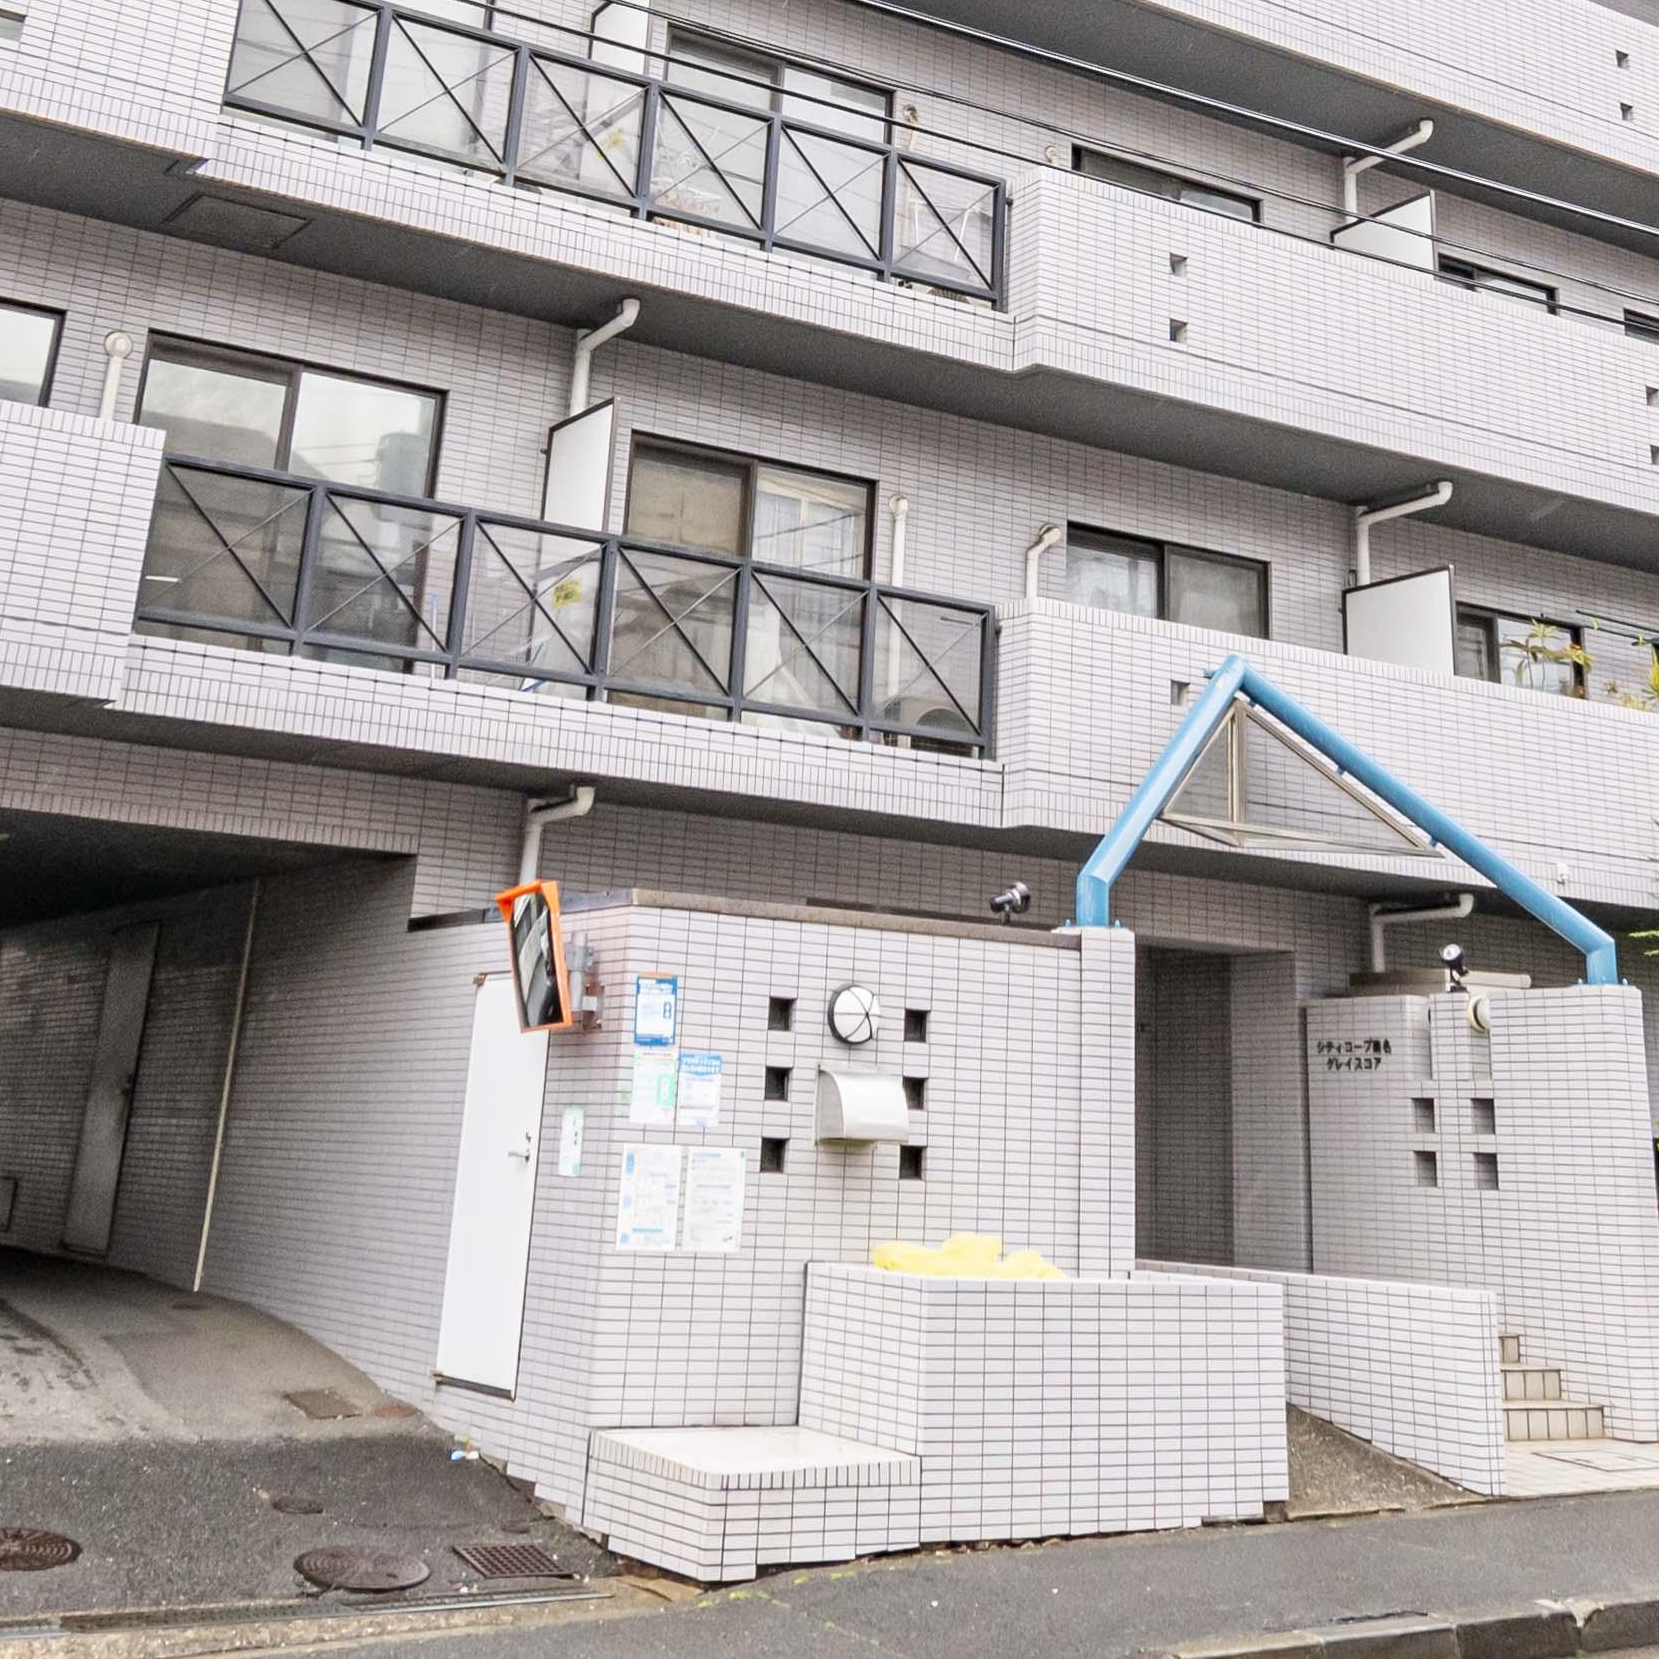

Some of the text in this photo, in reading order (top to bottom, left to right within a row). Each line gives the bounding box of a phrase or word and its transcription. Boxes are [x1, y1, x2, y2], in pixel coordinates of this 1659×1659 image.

[1327, 1057, 1382, 1071] グレイスコア
